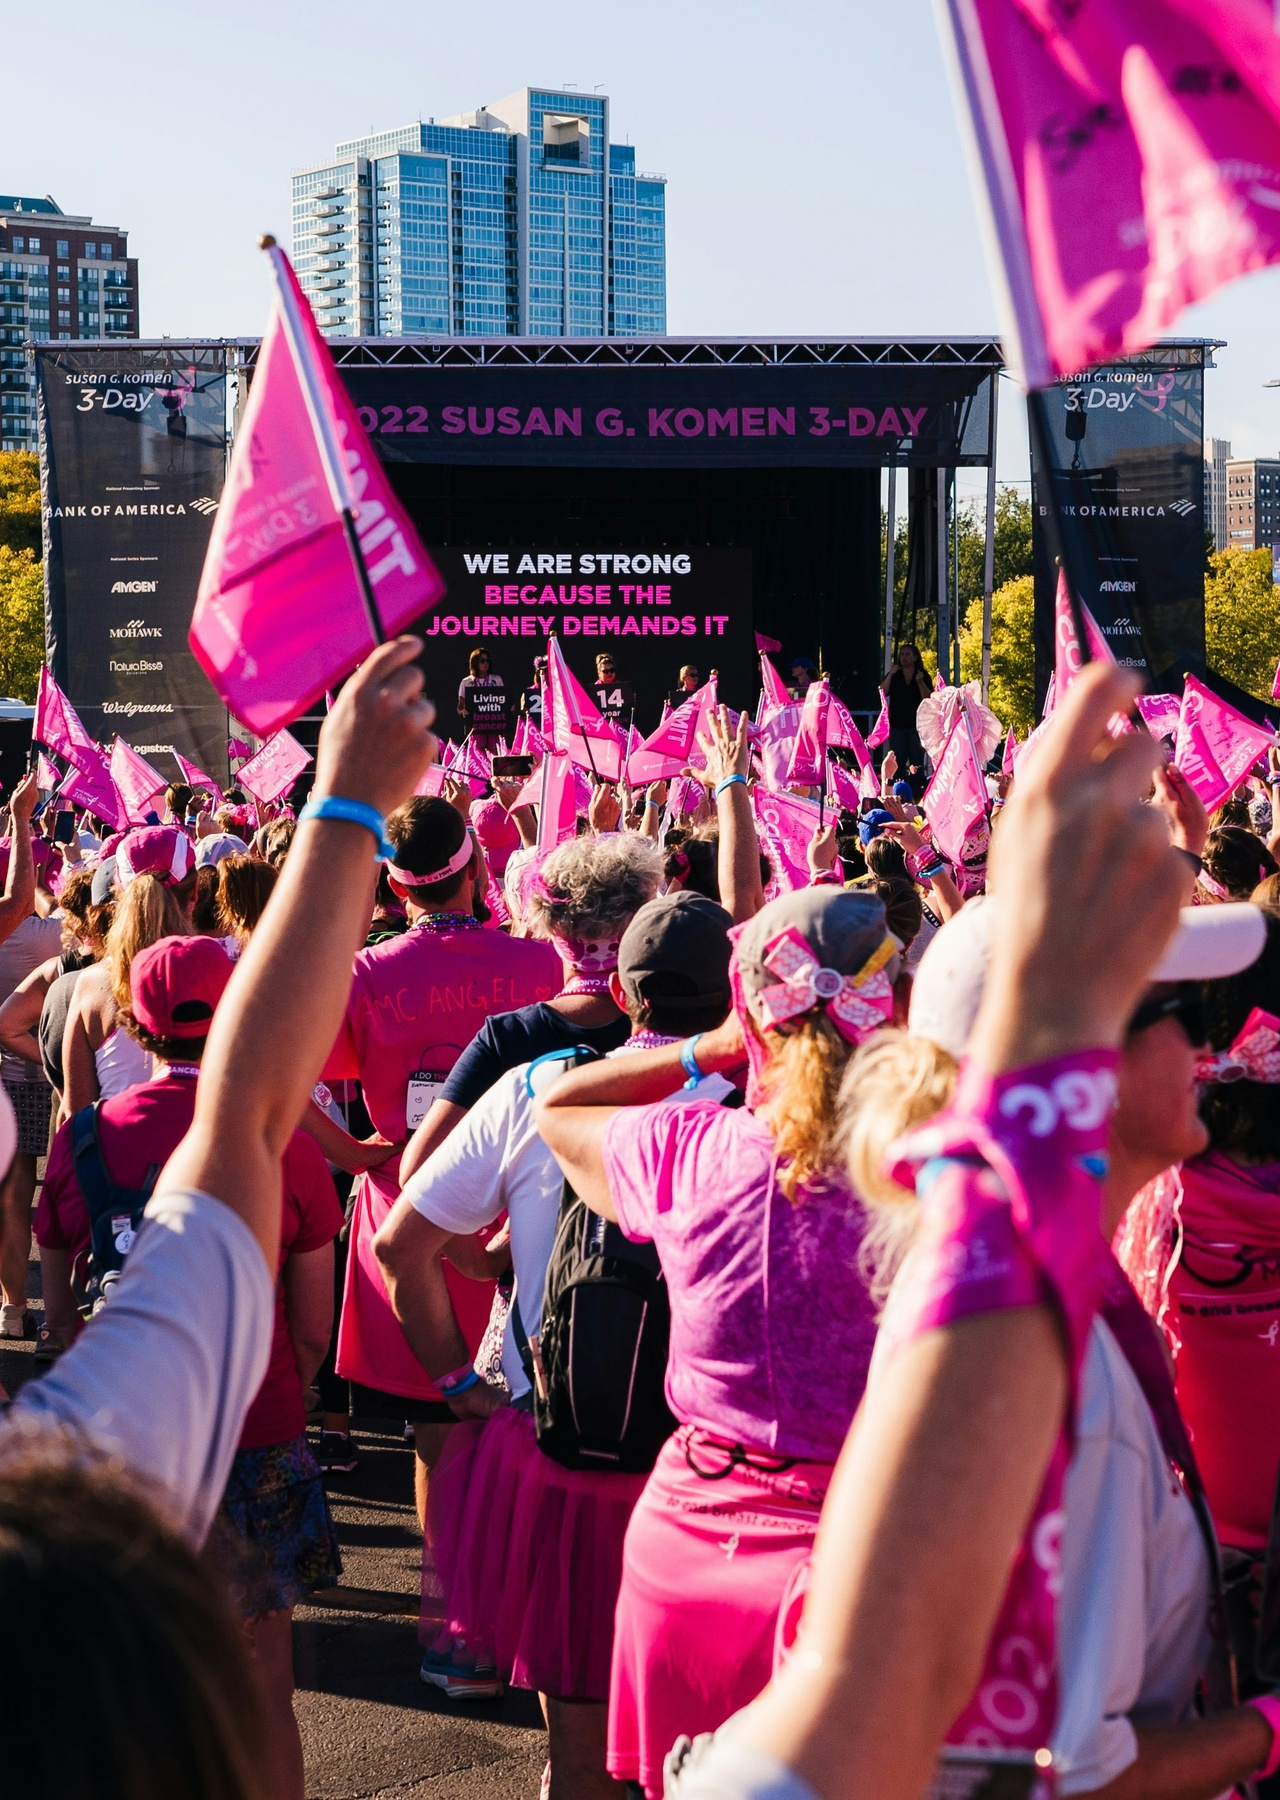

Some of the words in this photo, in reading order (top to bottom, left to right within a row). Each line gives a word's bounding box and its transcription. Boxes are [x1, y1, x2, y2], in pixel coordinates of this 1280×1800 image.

[65, 374, 106, 384] susan
[110, 374, 120, 384] G.
[1094, 373, 1104, 383] G.
[355, 405, 429, 433] 022
[441, 405, 582, 436] SUSAN
[595, 407, 635, 437] G.
[648, 407, 796, 437] KOMEN
[808, 407, 928, 437] 3-DAY
[91, 505, 111, 516] OF
[114, 504, 186, 516] AMERICA
[1099, 506, 1166, 517] AMERICA
[463, 554, 509, 574] WE
[516, 554, 572, 574] ARE
[579, 554, 691, 574] STRONG
[111, 581, 156, 593] AMGEN
[1099, 581, 1136, 592] AMGEN
[484, 585, 611, 605] BECAUSE
[618, 585, 672, 605] THE
[426, 616, 556, 636] JOURNEY
[563, 616, 697, 636] DEMANDS
[704, 616, 730, 636] IT
[1101, 626, 1142, 635] MOHAWK
[109, 628, 163, 638] MOHAWK
[473, 695, 506, 704] Living
[597, 689, 624, 708] 14
[101, 701, 174, 717] Walgreens
[478, 703, 501, 712] with
[473, 713, 506, 721] breast
[602, 710, 621, 719] year
[473, 722, 506, 730] cancer
[429, 978, 526, 1015] ANGEL
[419, 1072, 432, 1080] DO
[1200, 1304, 1232, 1317] end
[712, 1504, 758, 1525] breast
[762, 1517, 812, 1535] cancer
